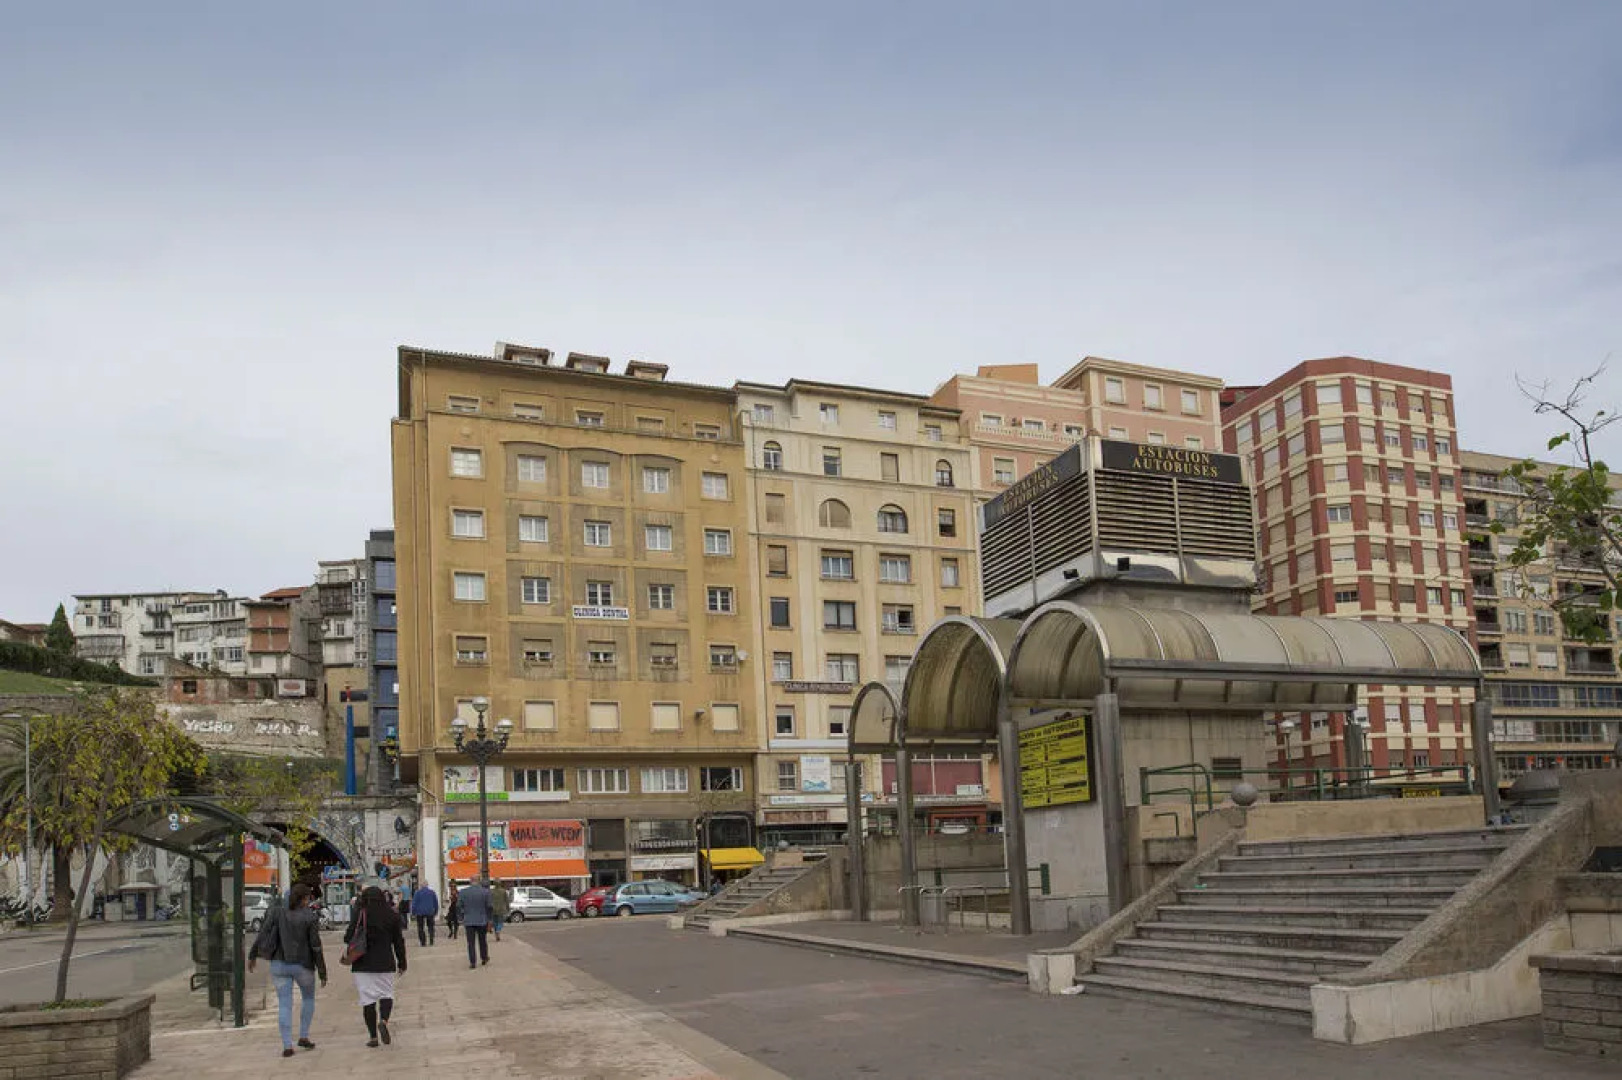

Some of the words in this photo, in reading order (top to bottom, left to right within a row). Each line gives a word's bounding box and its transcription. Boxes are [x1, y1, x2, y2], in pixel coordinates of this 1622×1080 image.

[1138, 444, 1209, 465] ESTACION
[1133, 457, 1218, 478] AUTOBUSES
[510, 825, 582, 842] HALLOWEEN
